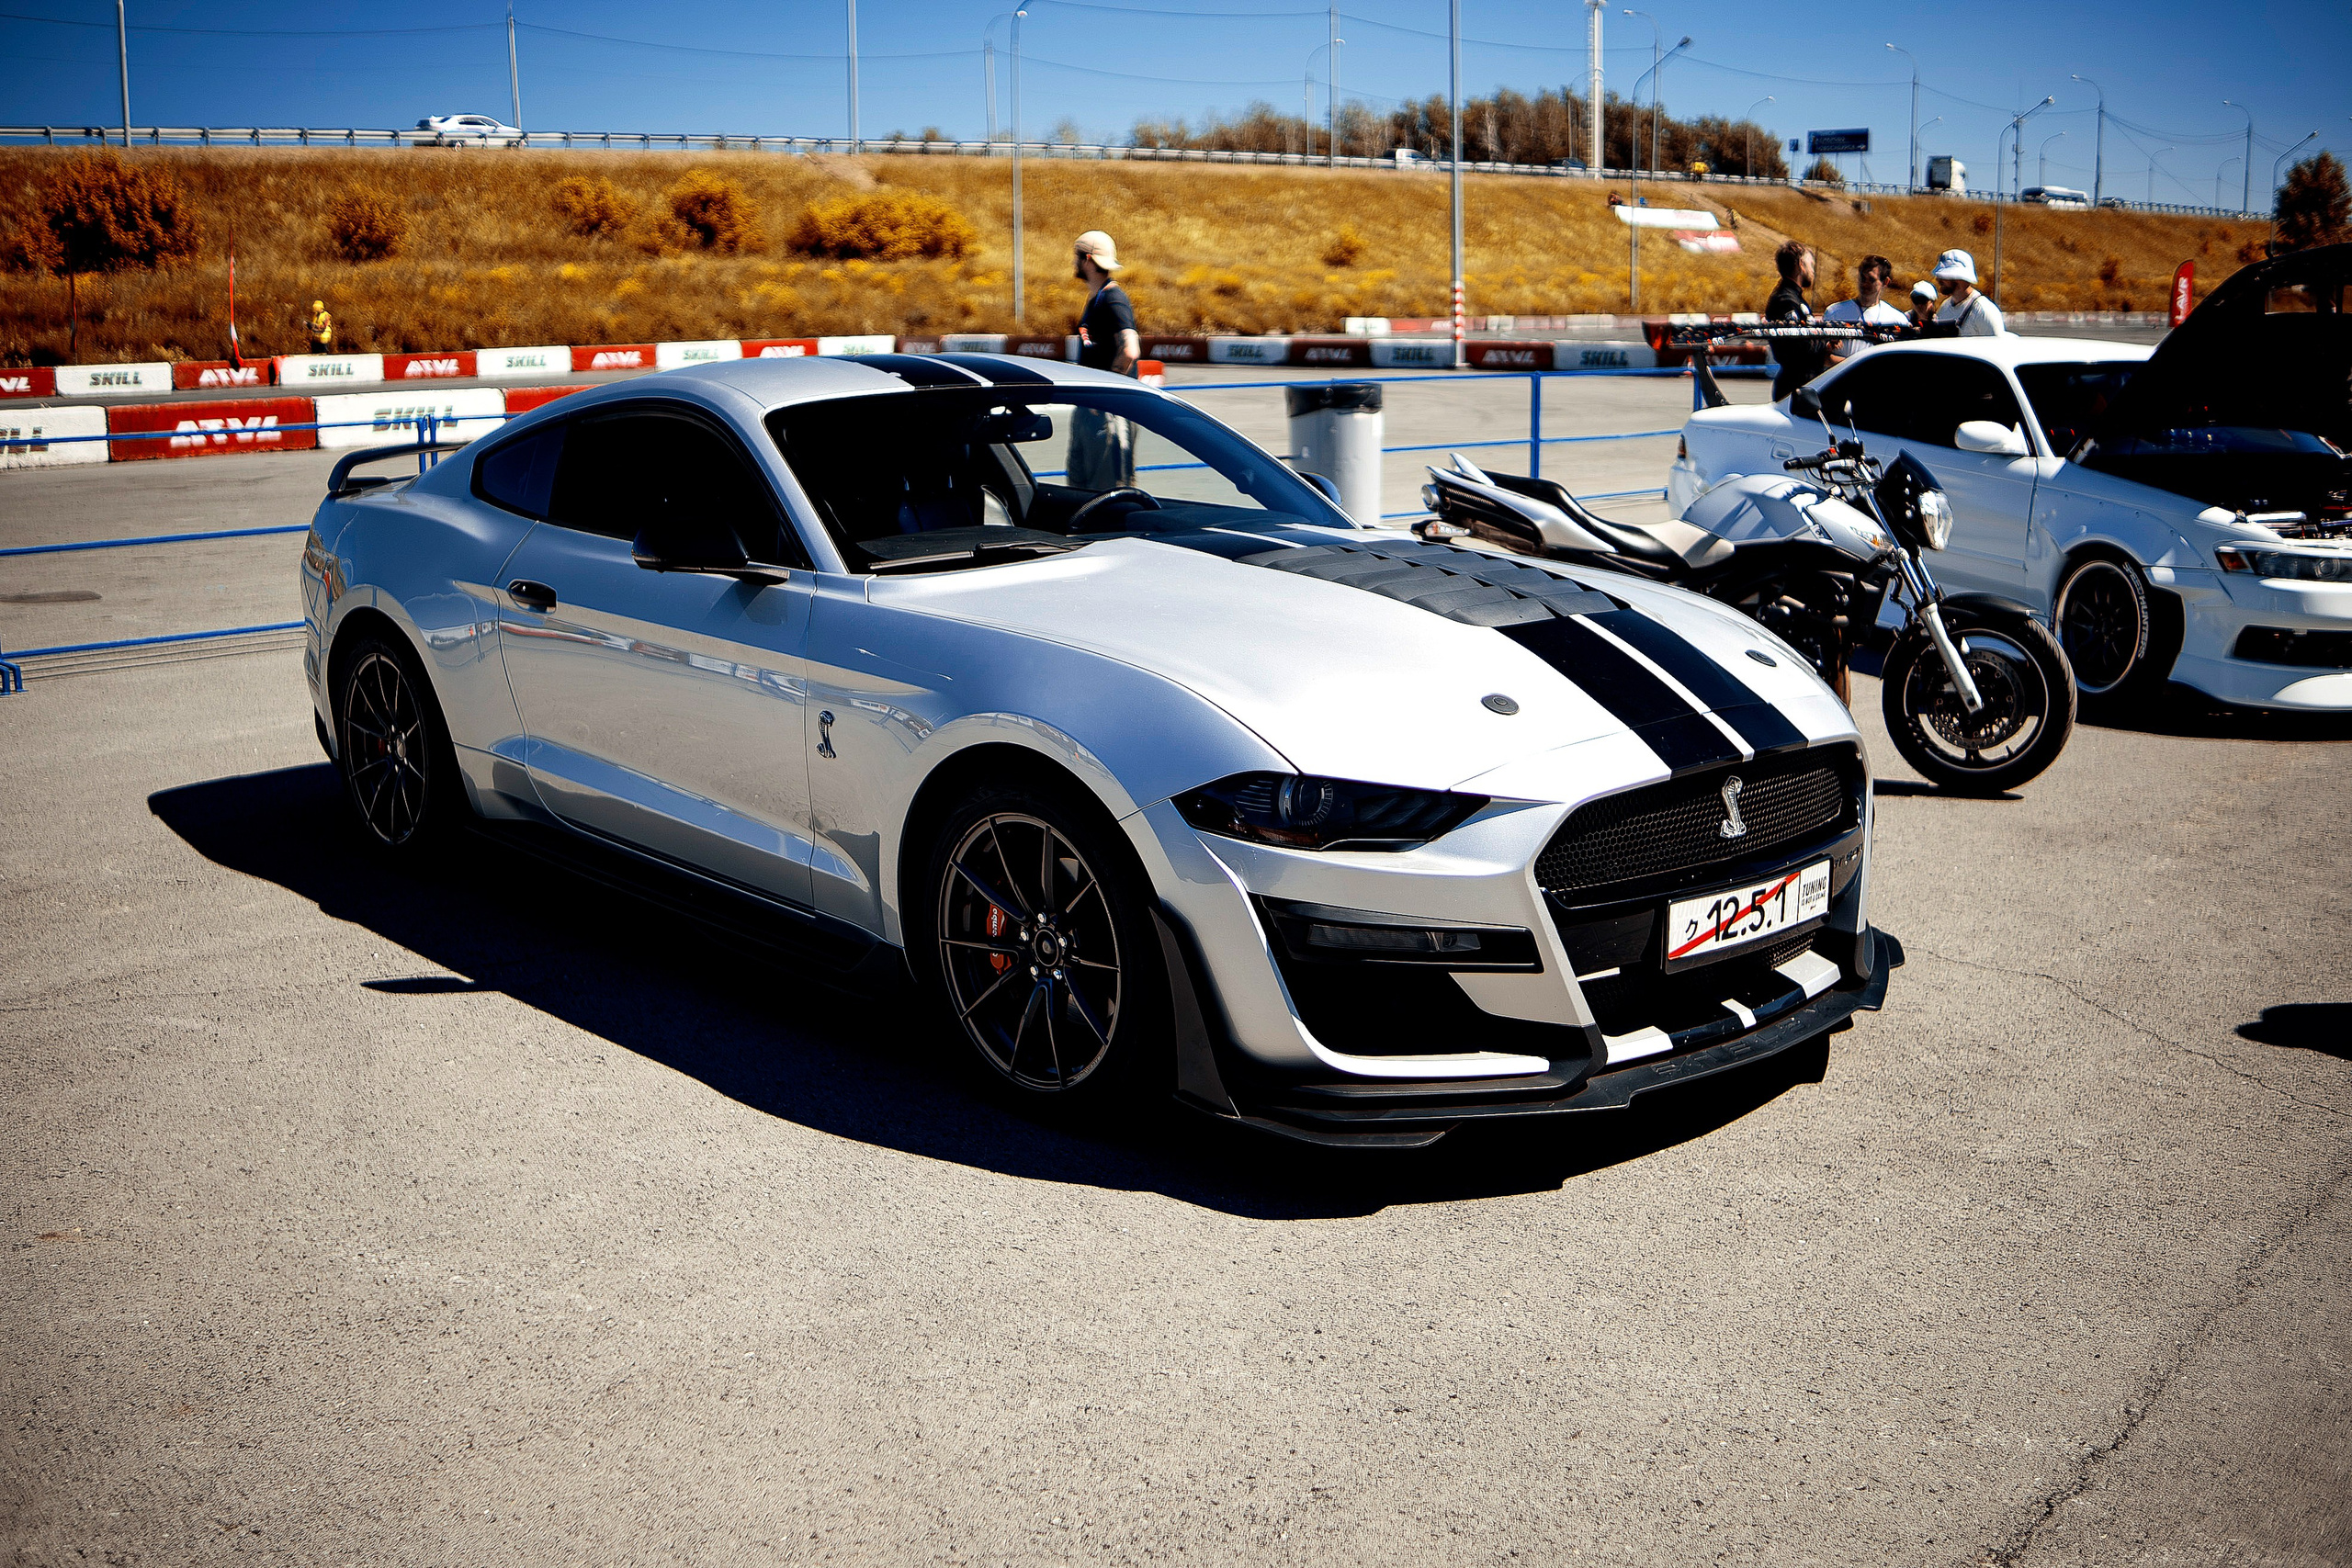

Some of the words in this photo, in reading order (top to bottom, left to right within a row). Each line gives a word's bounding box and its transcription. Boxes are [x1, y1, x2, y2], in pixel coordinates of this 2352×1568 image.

[505, 355, 548, 368] SKILL
[1580, 349, 1630, 367] SKILL
[308, 363, 355, 377] SKILL
[89, 371, 142, 387] SKILL
[1803, 875, 1827, 898] TUNING
[1707, 881, 1787, 942] 12.5.1
